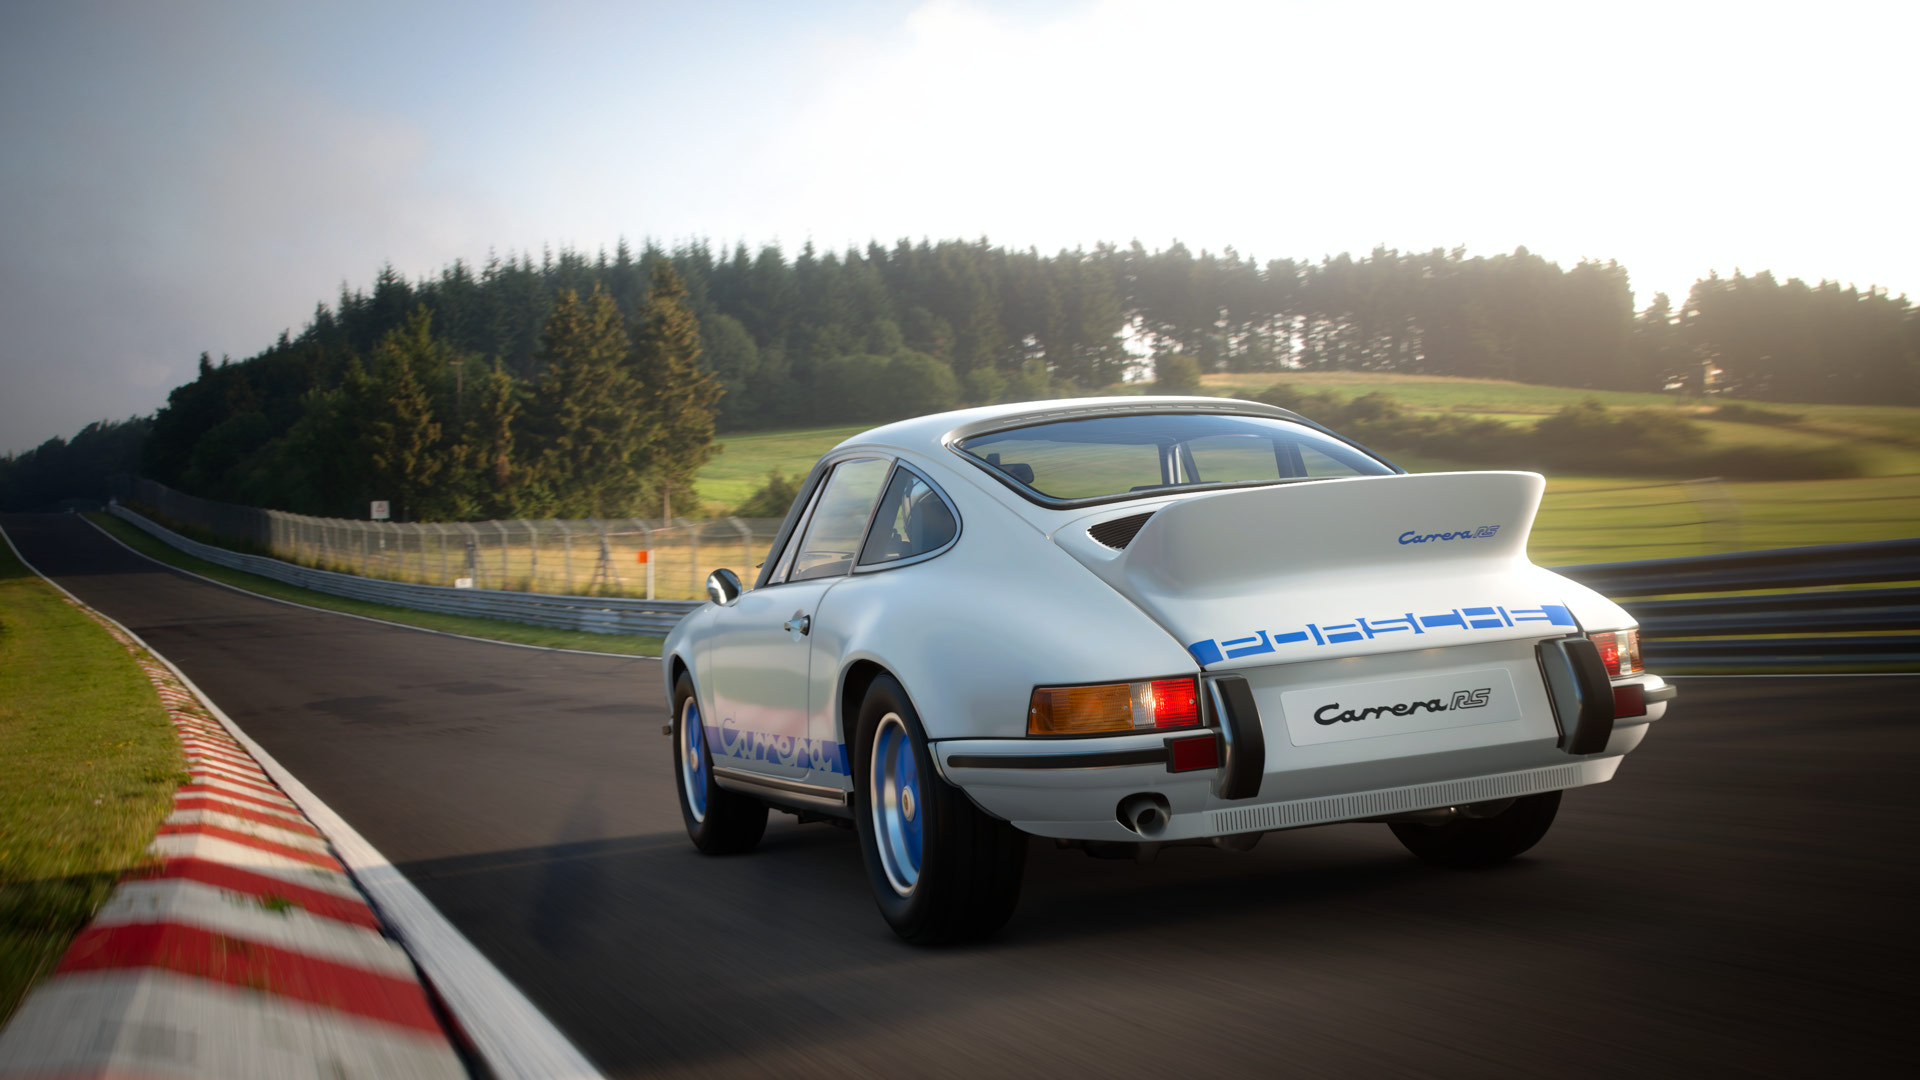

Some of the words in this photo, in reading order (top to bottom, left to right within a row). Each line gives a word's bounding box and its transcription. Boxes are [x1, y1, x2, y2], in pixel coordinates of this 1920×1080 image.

[1398, 530, 1473, 545] Carrera
[1472, 525, 1500, 538] RS
[1213, 604, 1553, 662] PORSCHE
[1314, 699, 1448, 726] Carrera
[1450, 688, 1491, 711] RS
[719, 714, 833, 773] Carrera
